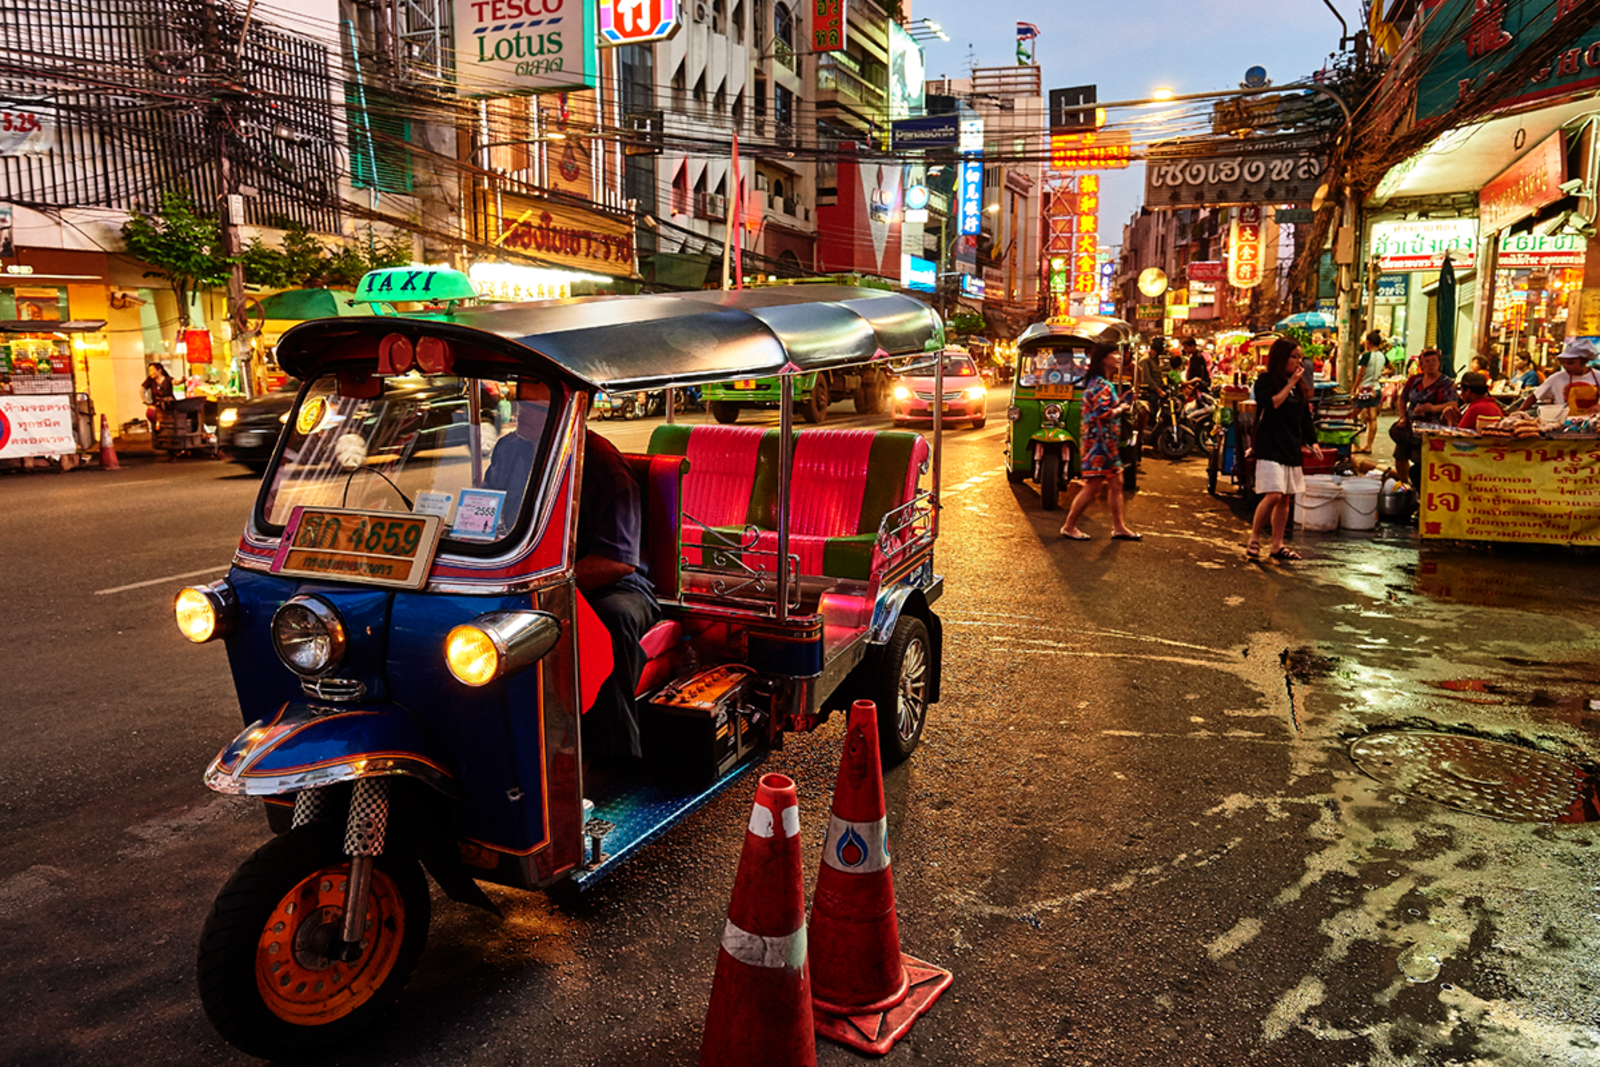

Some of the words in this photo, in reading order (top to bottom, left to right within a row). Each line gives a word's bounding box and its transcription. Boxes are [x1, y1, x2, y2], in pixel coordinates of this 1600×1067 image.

[471, 0, 563, 22] TESCO
[477, 30, 563, 63] Lotus
[515, 57, 563, 77] ตลาด
[366, 271, 437, 292] TAXI
[17, 418, 61, 432] ทุกชนิด
[10, 435, 72, 445] ตลอดเวลา
[474, 506, 496, 517] 2558
[348, 520, 421, 555] 4659
